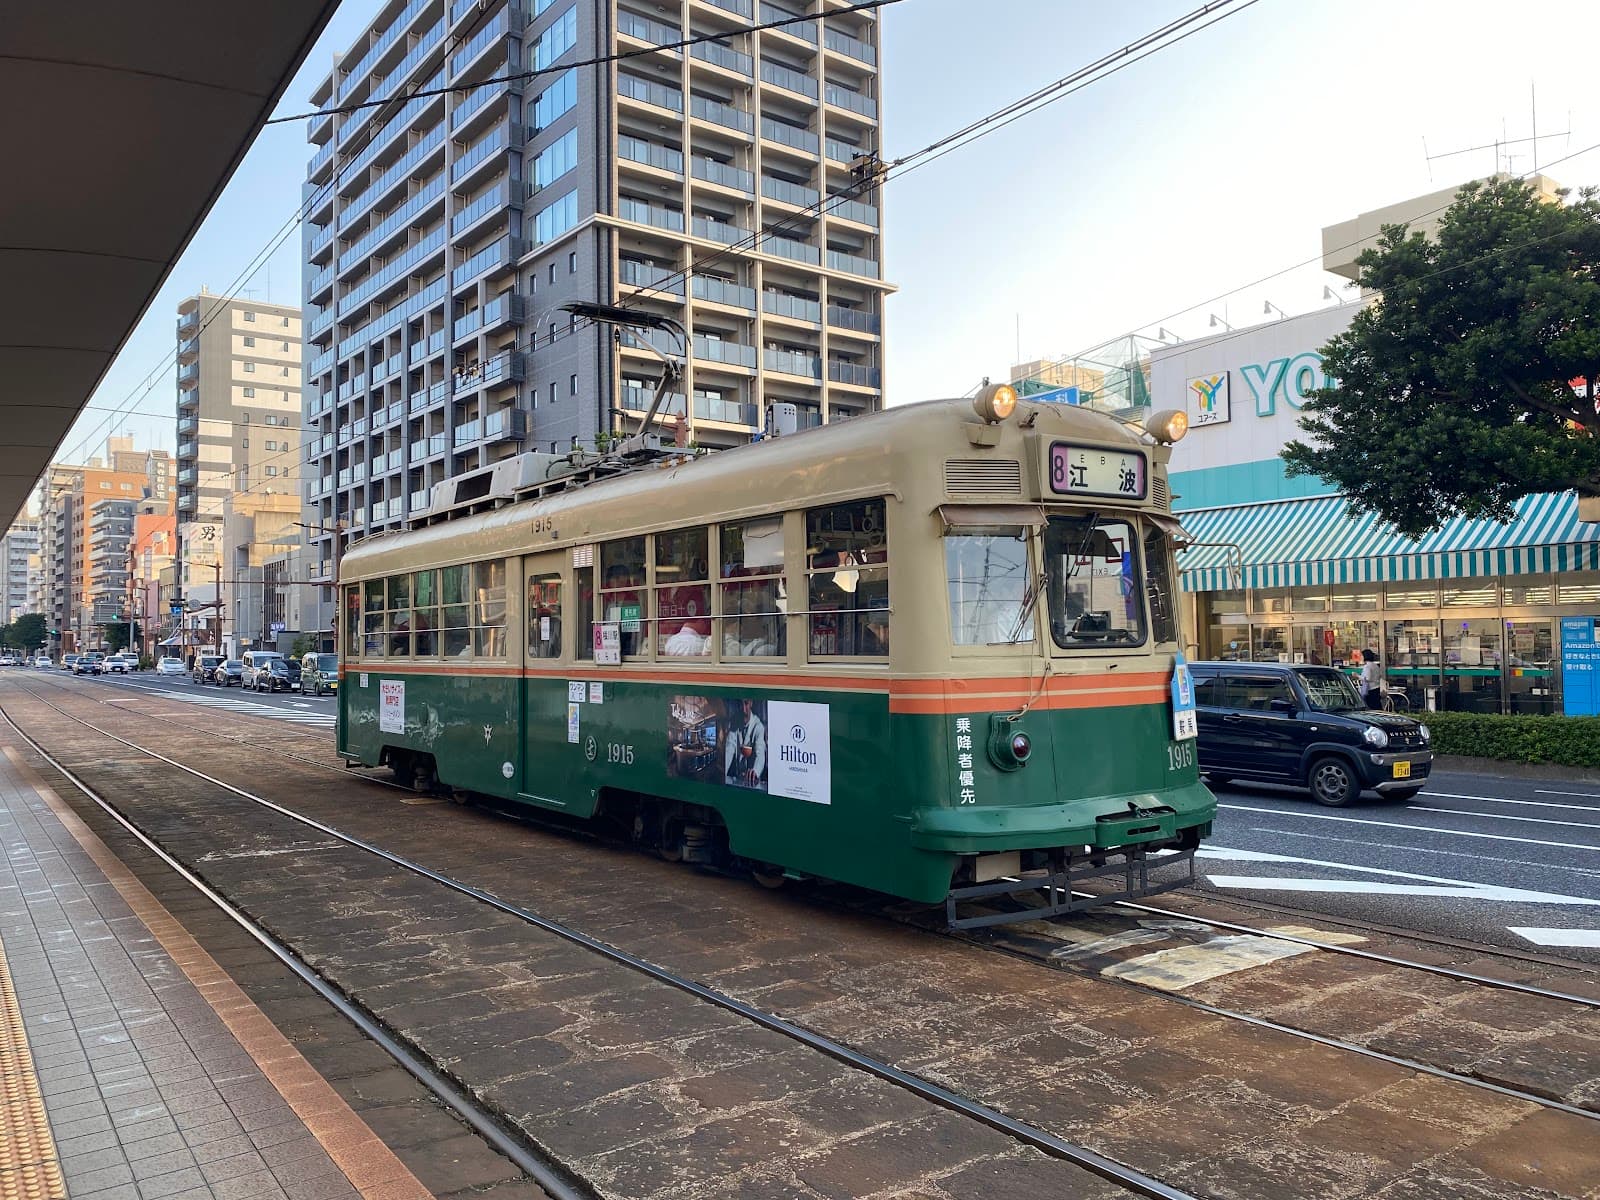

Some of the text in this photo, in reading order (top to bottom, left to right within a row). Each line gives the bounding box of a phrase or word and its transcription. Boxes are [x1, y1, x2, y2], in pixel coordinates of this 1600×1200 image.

[1053, 455, 1065, 483] 8
[1069, 464, 1136, 493] 江波
[531, 516, 552, 535] 1915
[595, 630, 603, 646] 8
[607, 742, 634, 765] 1915
[780, 744, 817, 765] Hilton
[956, 717, 976, 805] 乗降者優先
[1167, 743, 1193, 771] 1915
